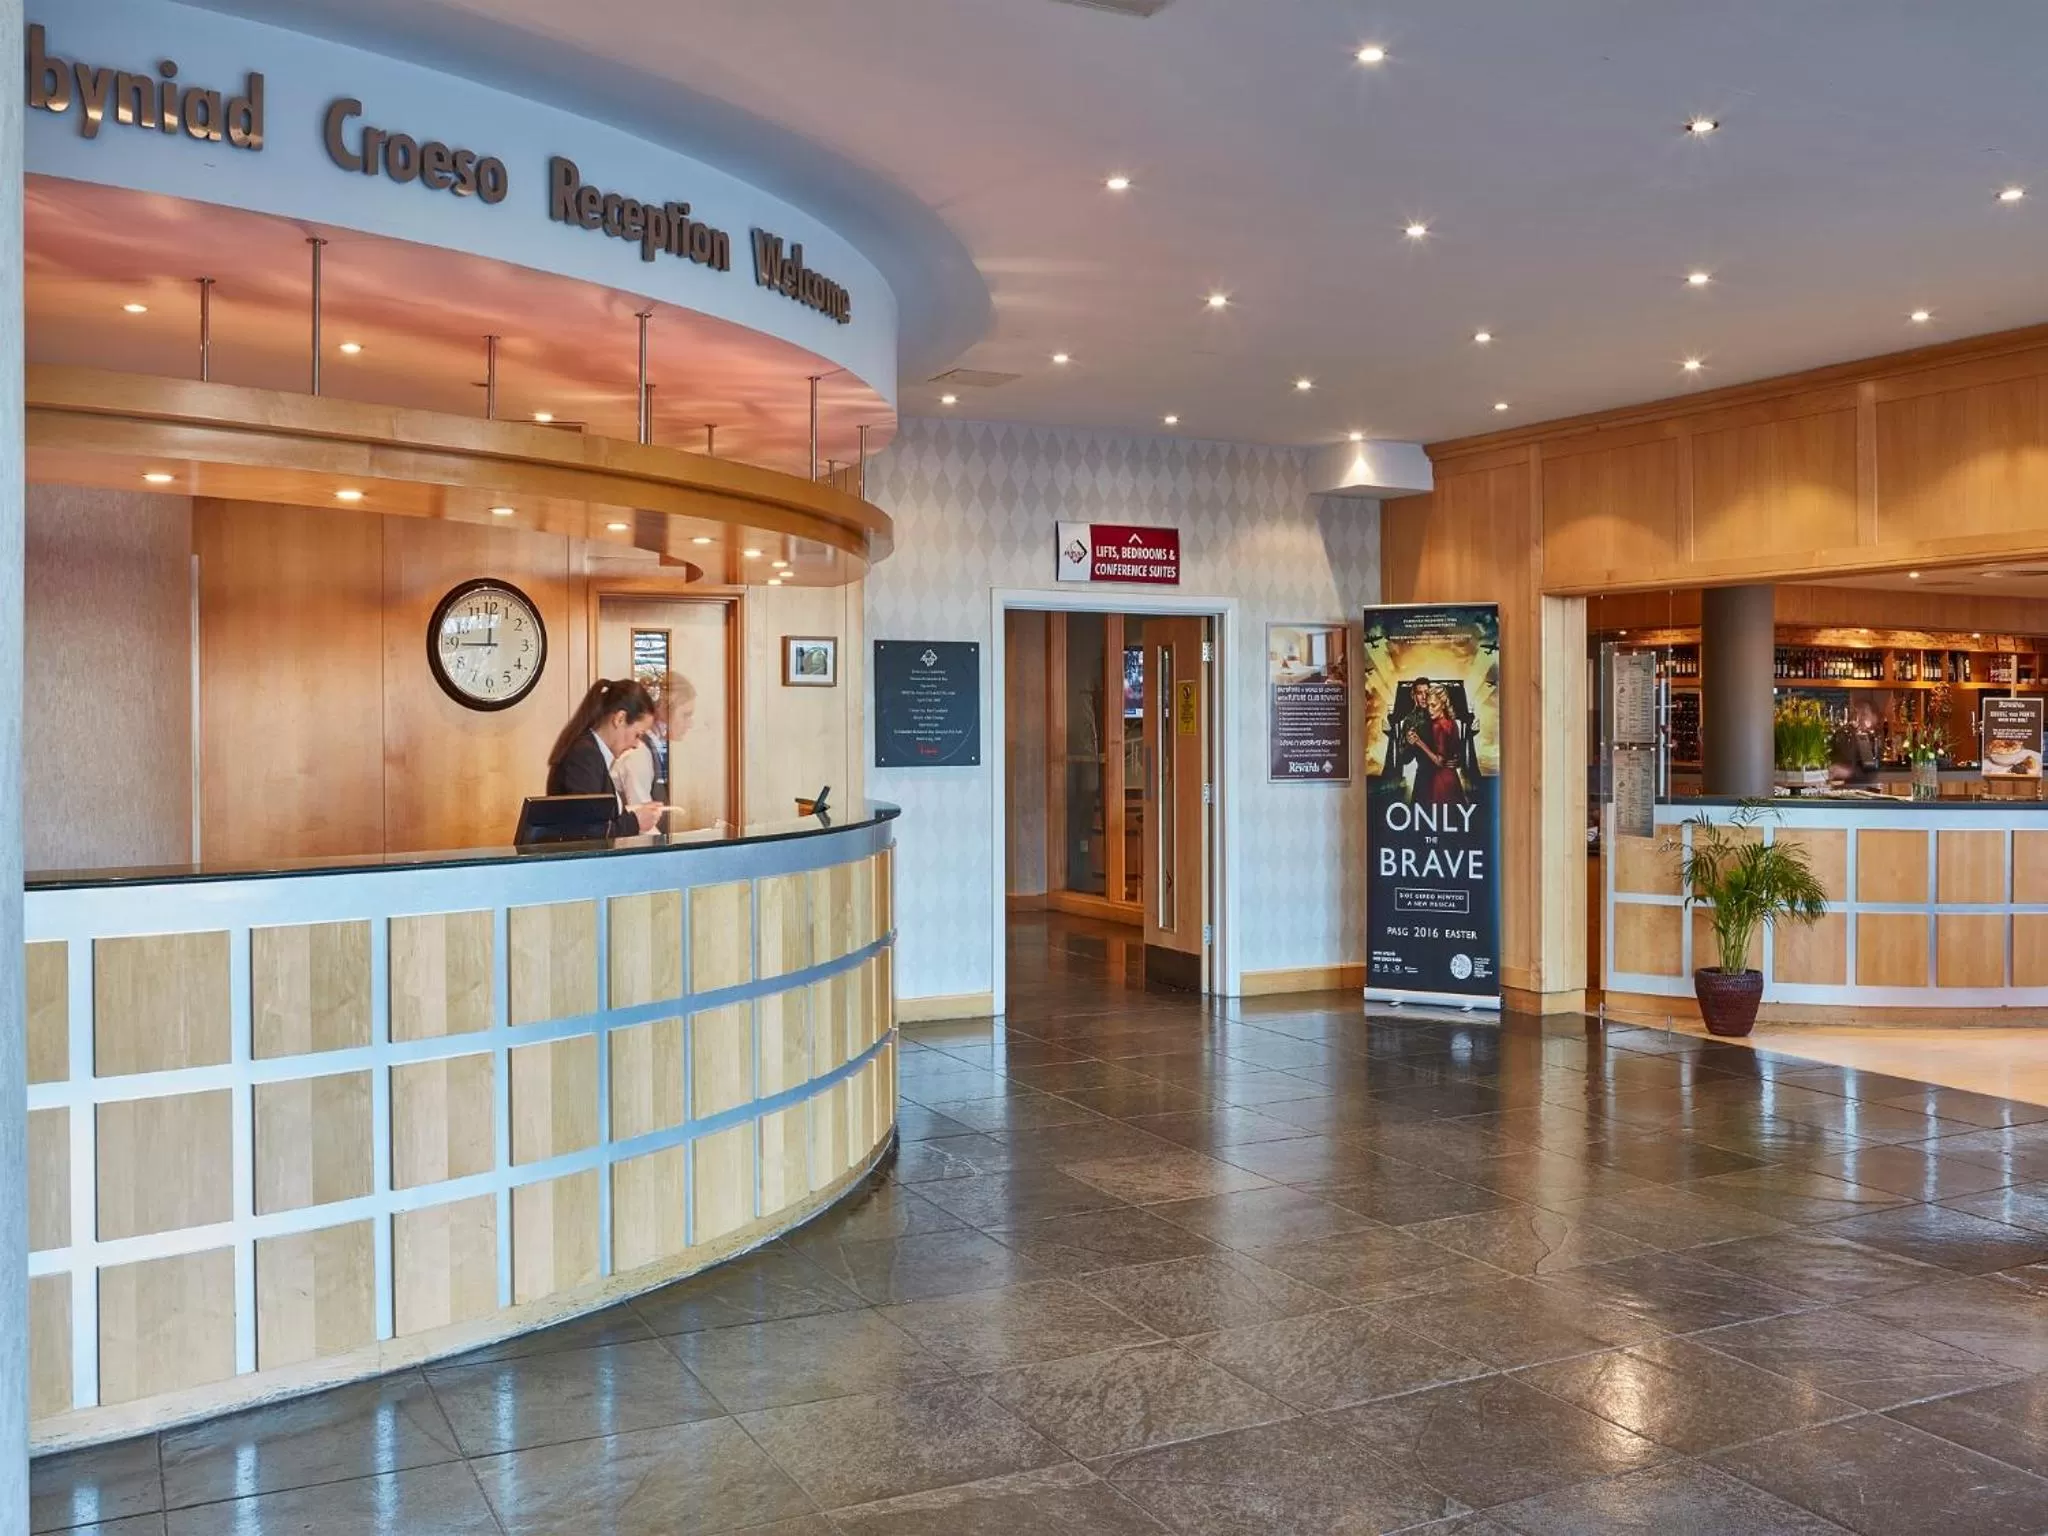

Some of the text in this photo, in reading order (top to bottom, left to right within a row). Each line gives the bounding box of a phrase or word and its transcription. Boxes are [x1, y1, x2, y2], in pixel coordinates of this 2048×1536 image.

[323, 97, 508, 205] Croeso
[549, 154, 731, 272] Reception
[751, 227, 852, 325] Welcome
[1096, 545, 1120, 560] LIFTS,
[1121, 546, 1167, 560] BEDROOMS
[1168, 549, 1176, 561] &
[1094, 563, 1177, 578] CONFERENCE SUITES
[484, 601, 498, 615] 12
[514, 618, 522, 631] 2
[450, 636, 459, 649] 9
[521, 639, 529, 652] 3
[513, 658, 522, 670] 4
[503, 671, 511, 683] 5
[1288, 761, 1320, 773] Rewards
[1385, 802, 1477, 833] ONLY
[1425, 836, 1439, 844] THE
[1380, 847, 1484, 879] BRAVE
[1386, 926, 1477, 940] PASG 2016 EASTER
